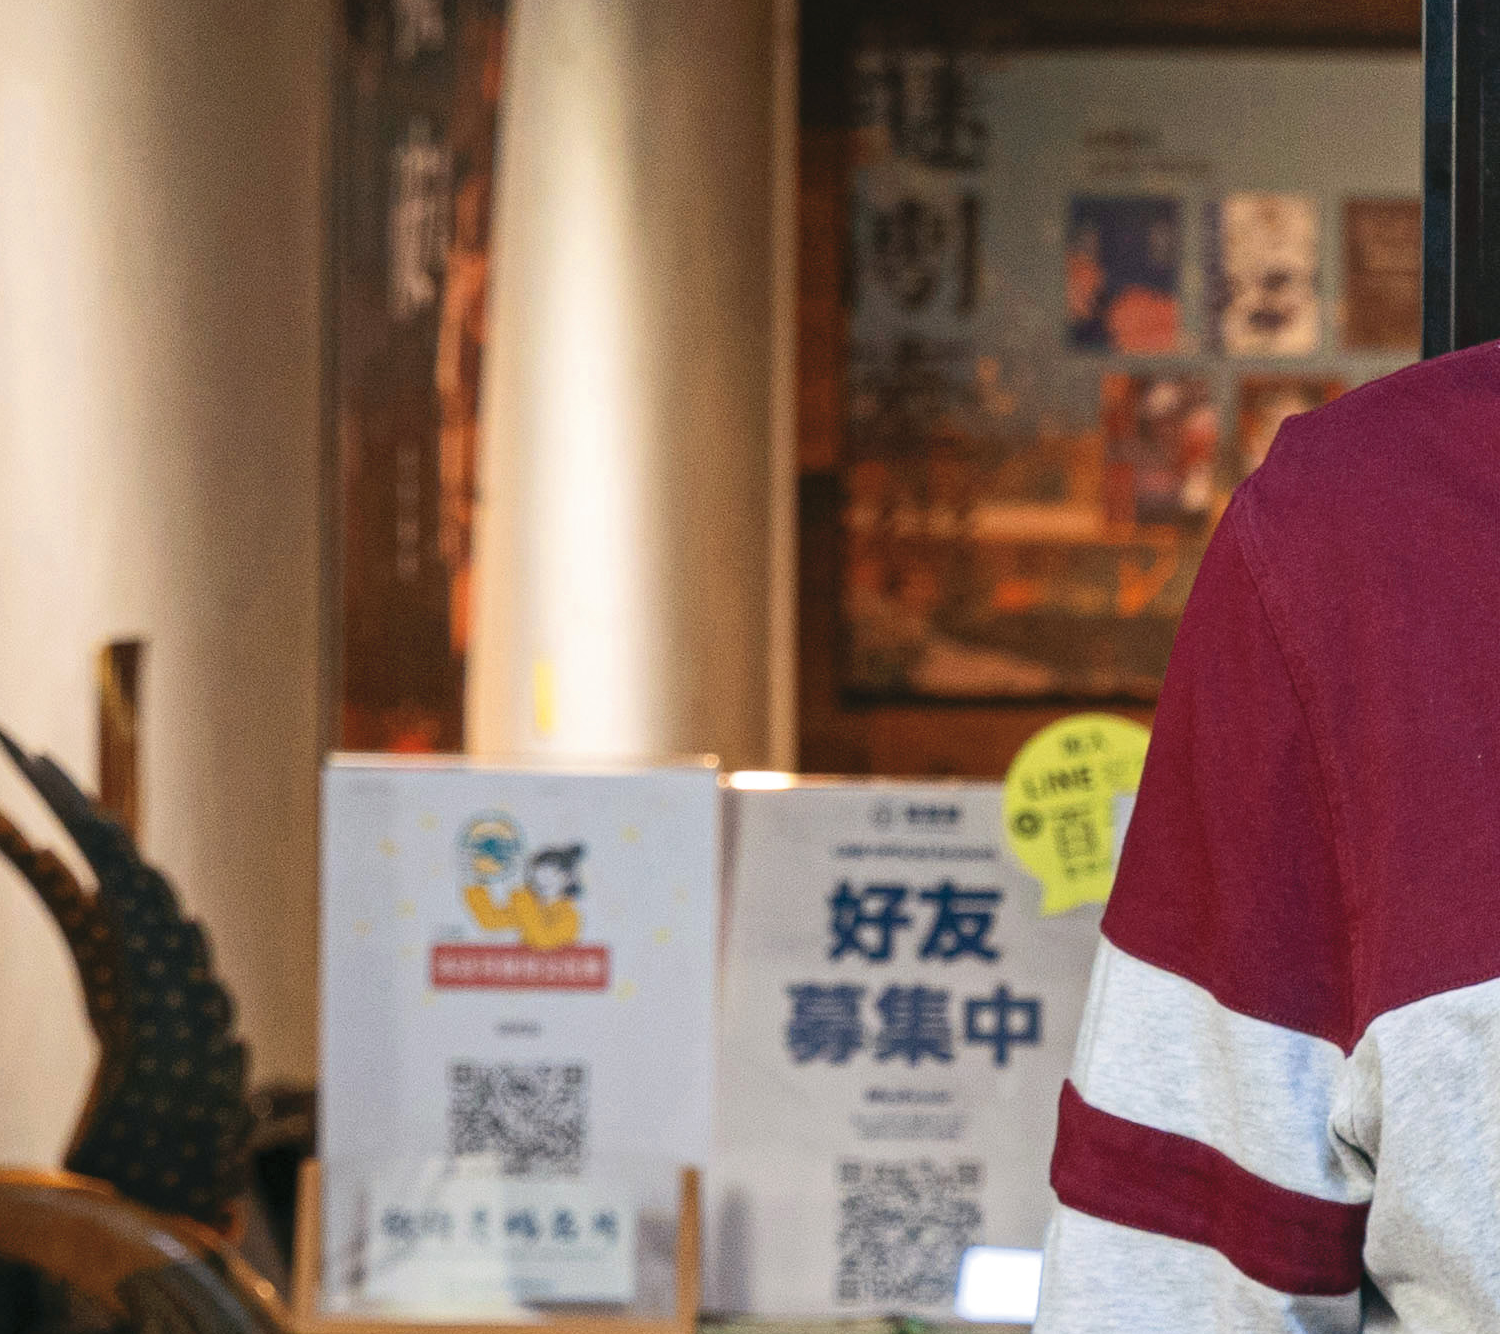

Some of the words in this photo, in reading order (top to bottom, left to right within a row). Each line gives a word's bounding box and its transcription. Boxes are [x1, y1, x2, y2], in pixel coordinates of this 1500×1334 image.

[828, 879, 1003, 962] 好友
[786, 985, 1044, 1067] 募集中
